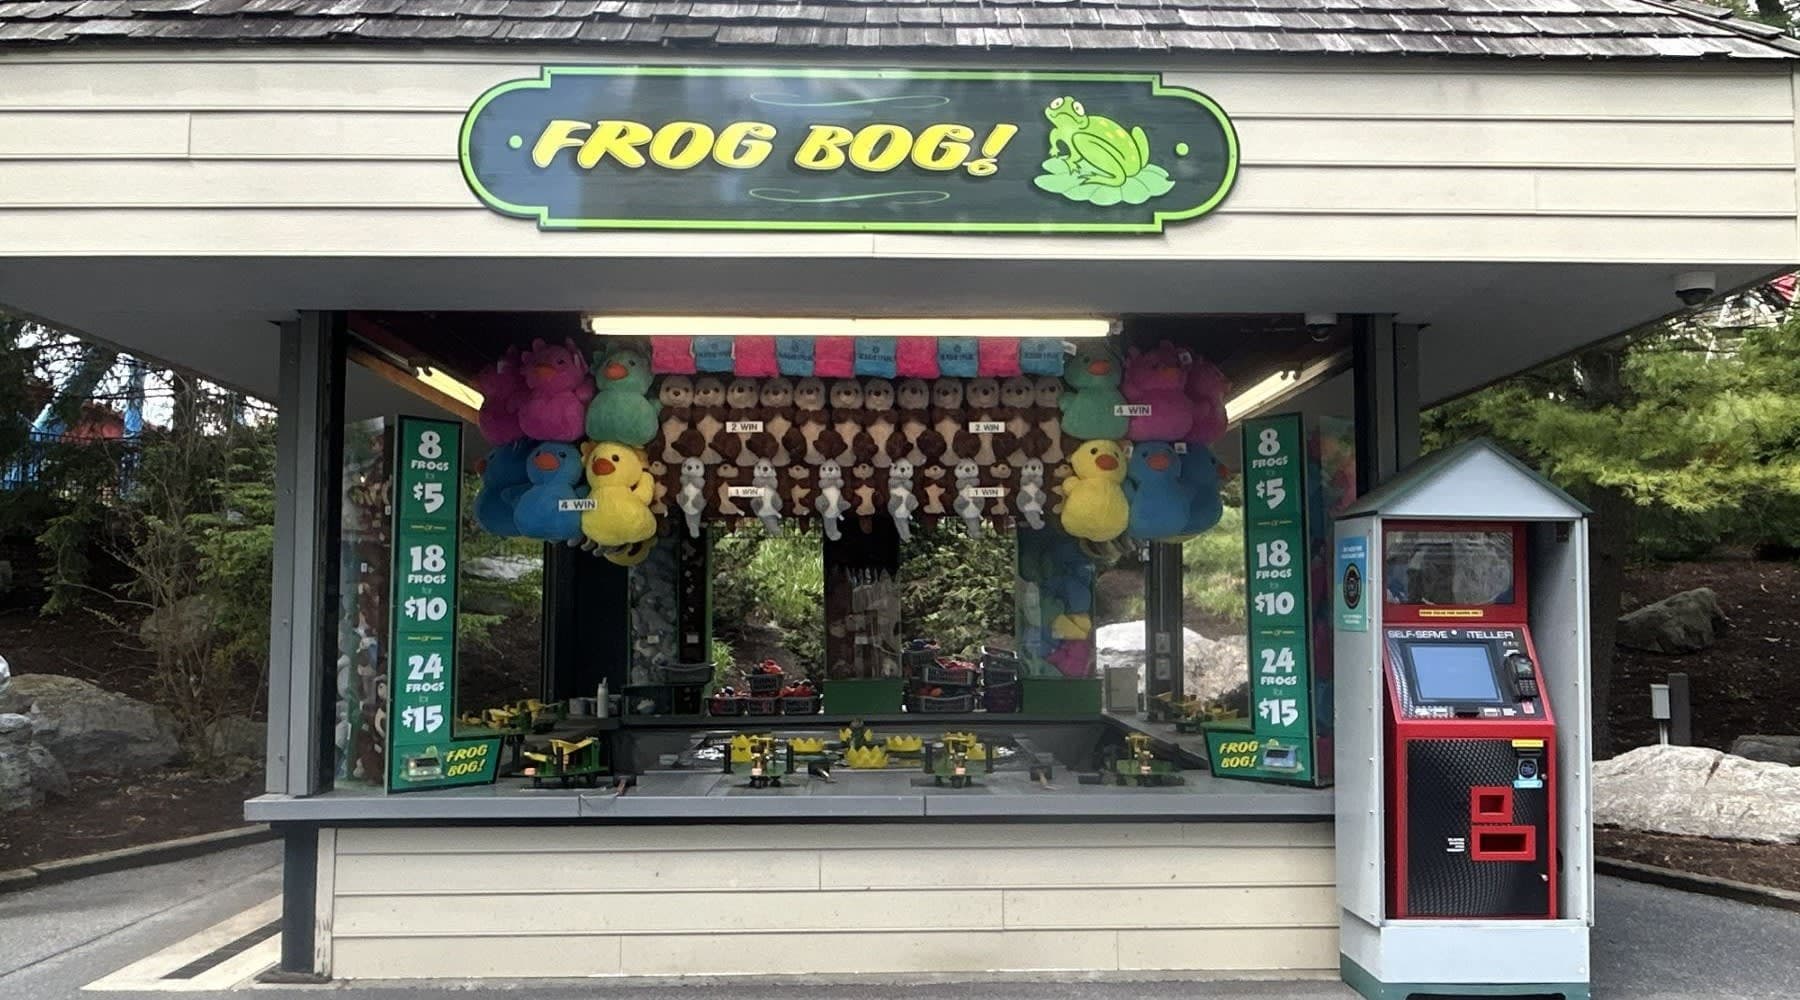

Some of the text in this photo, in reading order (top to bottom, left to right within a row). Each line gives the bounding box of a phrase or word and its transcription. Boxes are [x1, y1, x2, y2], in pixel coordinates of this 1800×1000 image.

[531, 119, 1019, 177] FROG BOG!
[1128, 406, 1150, 414] WIN
[740, 423, 758, 431] WIN
[418, 430, 442, 459] 8
[1258, 428, 1280, 456] 8
[410, 460, 449, 471] FROGS
[1252, 456, 1288, 469] FROGS
[413, 481, 445, 514] $5
[981, 488, 999, 496] WIN
[1256, 478, 1286, 510] $5
[561, 500, 596, 509] 4 WIN
[410, 545, 446, 572] 18
[1256, 539, 1291, 568] 18
[408, 574, 446, 584] FROGS
[1256, 568, 1292, 579] FROGS
[405, 596, 447, 621] $10
[1255, 591, 1295, 616] $10
[1387, 630, 1448, 639] SELF-SERVE
[408, 653, 444, 680] 24
[1261, 647, 1295, 673] 24
[406, 682, 445, 693] FROGS
[1261, 675, 1297, 686] FROGS
[402, 705, 444, 734] $15
[1258, 698, 1298, 727] $15
[446, 744, 488, 762] FROG
[1220, 740, 1259, 754] FROG
[447, 759, 486, 776] BOG!
[1221, 755, 1256, 768] BOG!
